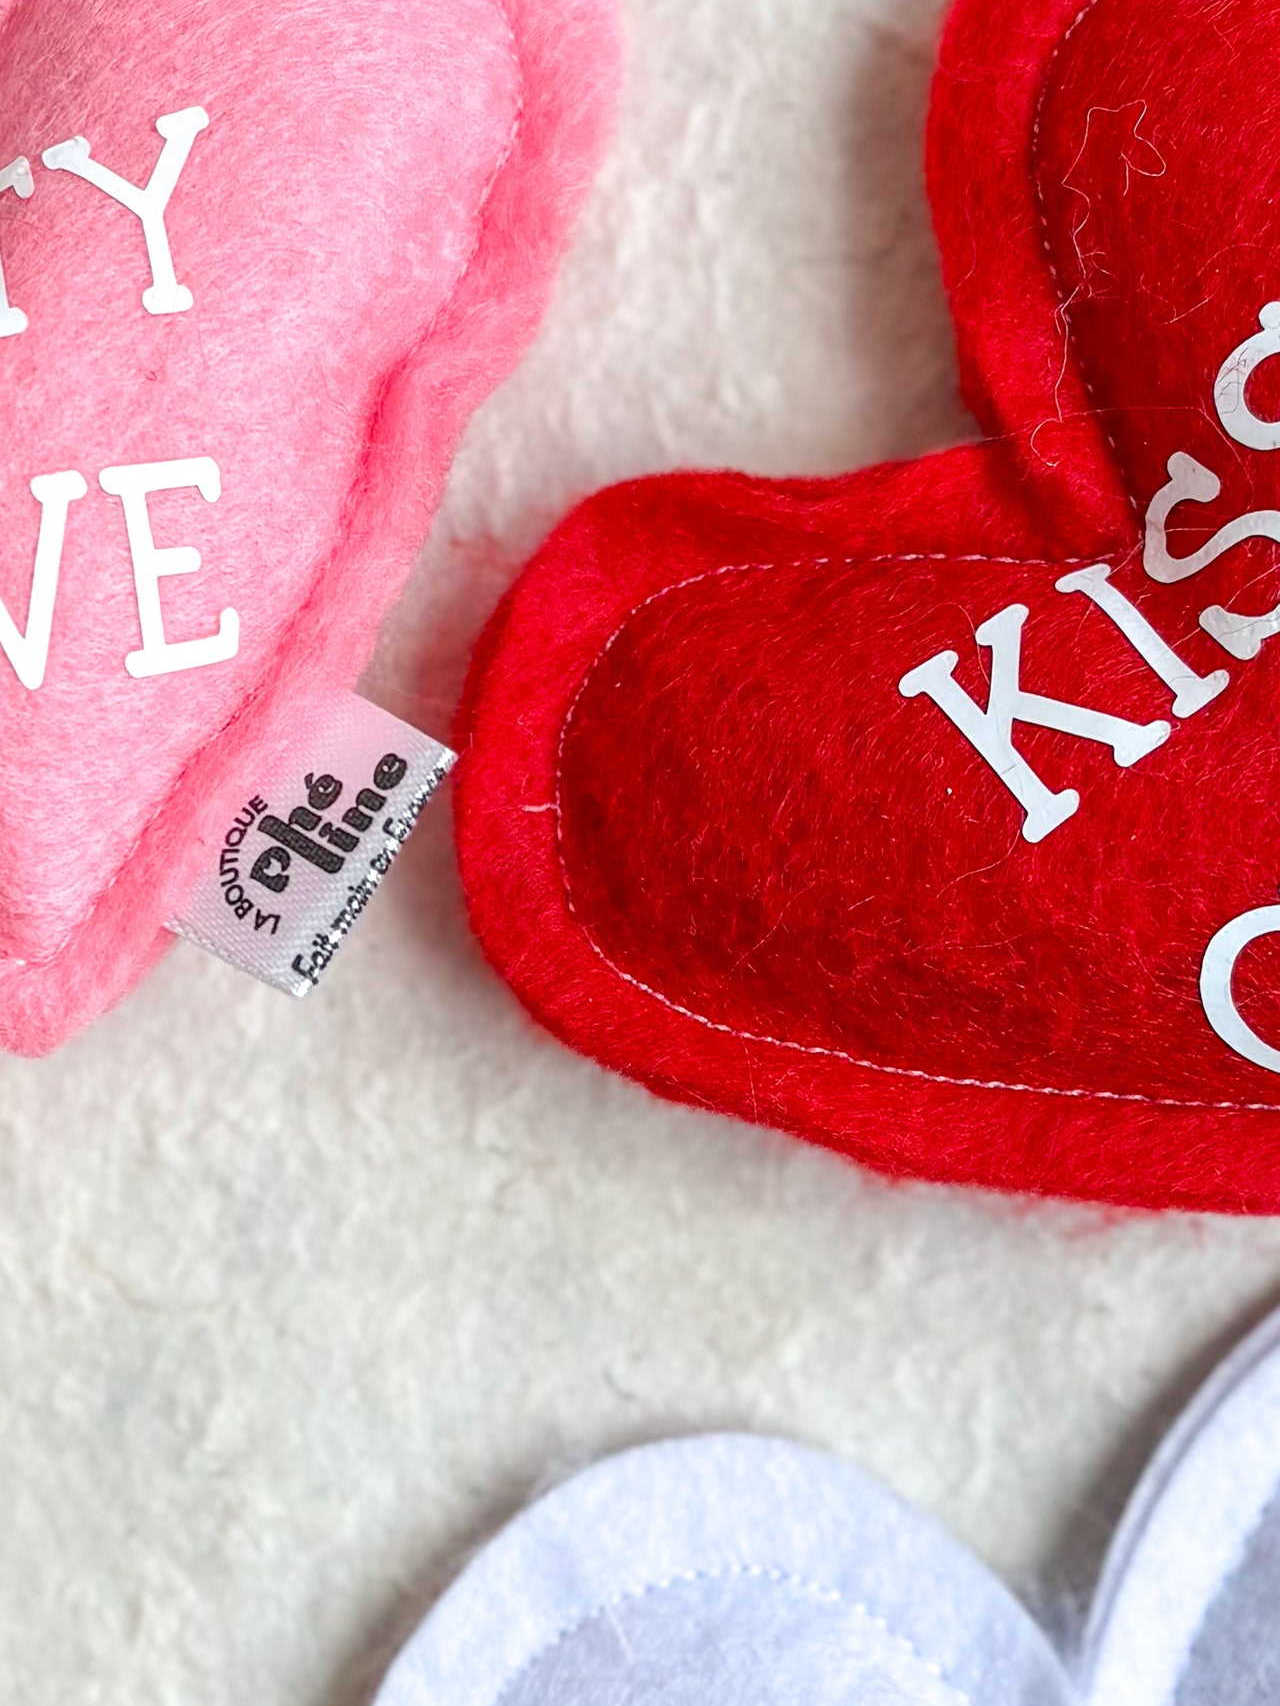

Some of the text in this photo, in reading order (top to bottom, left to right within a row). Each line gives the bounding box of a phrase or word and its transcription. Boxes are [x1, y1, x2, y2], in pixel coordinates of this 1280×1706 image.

[220, 794, 281, 935] LA BOUTIQUE
[291, 933, 339, 985] Fait
[331, 877, 378, 935] main
[370, 845, 398, 876] en
